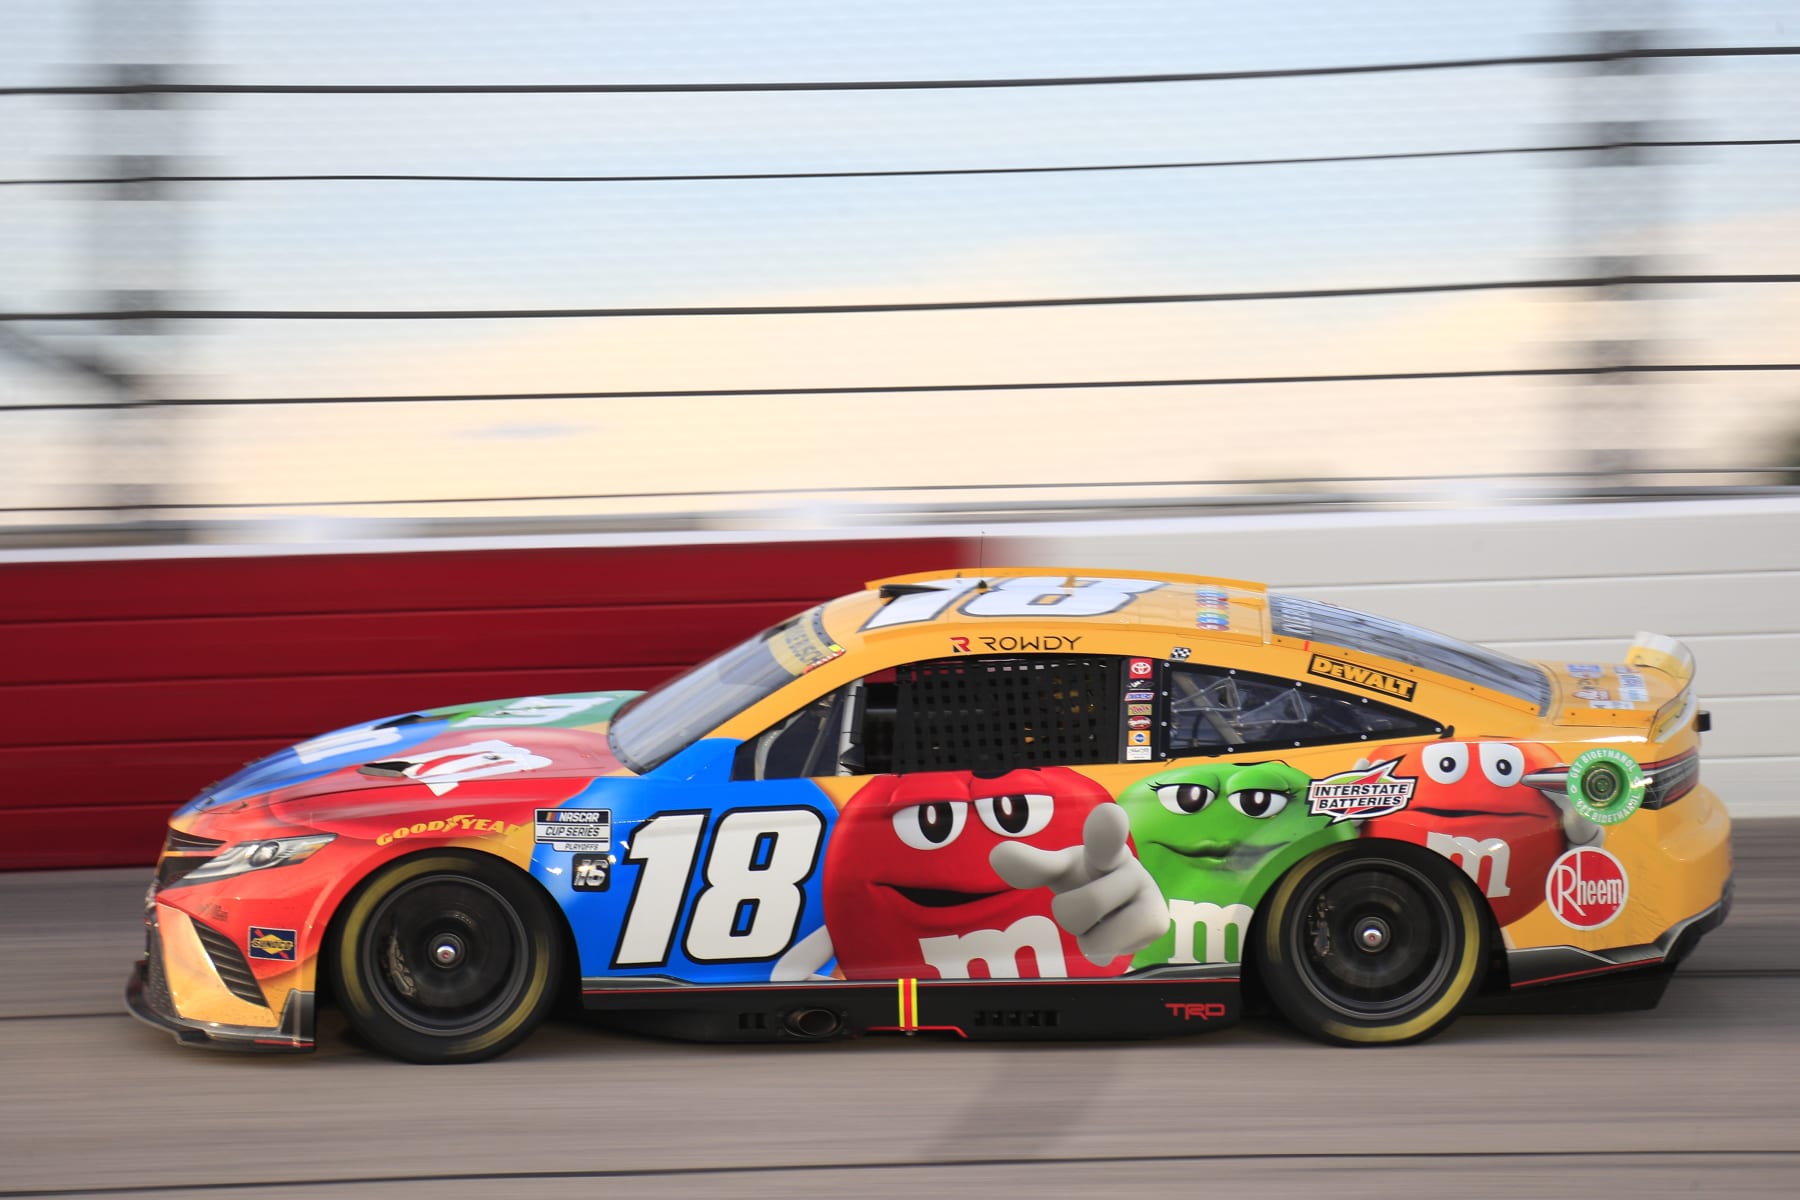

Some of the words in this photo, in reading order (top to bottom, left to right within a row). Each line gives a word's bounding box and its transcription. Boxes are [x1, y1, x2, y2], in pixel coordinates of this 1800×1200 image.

[857, 576, 1171, 633] 18
[978, 636, 1082, 651] ROWDY
[1315, 784, 1408, 796] INTERSTATE
[1319, 796, 1402, 809] BATTERIES
[559, 811, 600, 823] NASCAR
[375, 814, 521, 847] GOODYEAR
[545, 826, 565, 836] CUP
[566, 827, 600, 837] SERIES
[564, 843, 600, 851] PLAYOFFS
[608, 804, 828, 970] 18
[1557, 851, 1622, 917] Rheem
[1165, 1003, 1226, 1020] TRD
